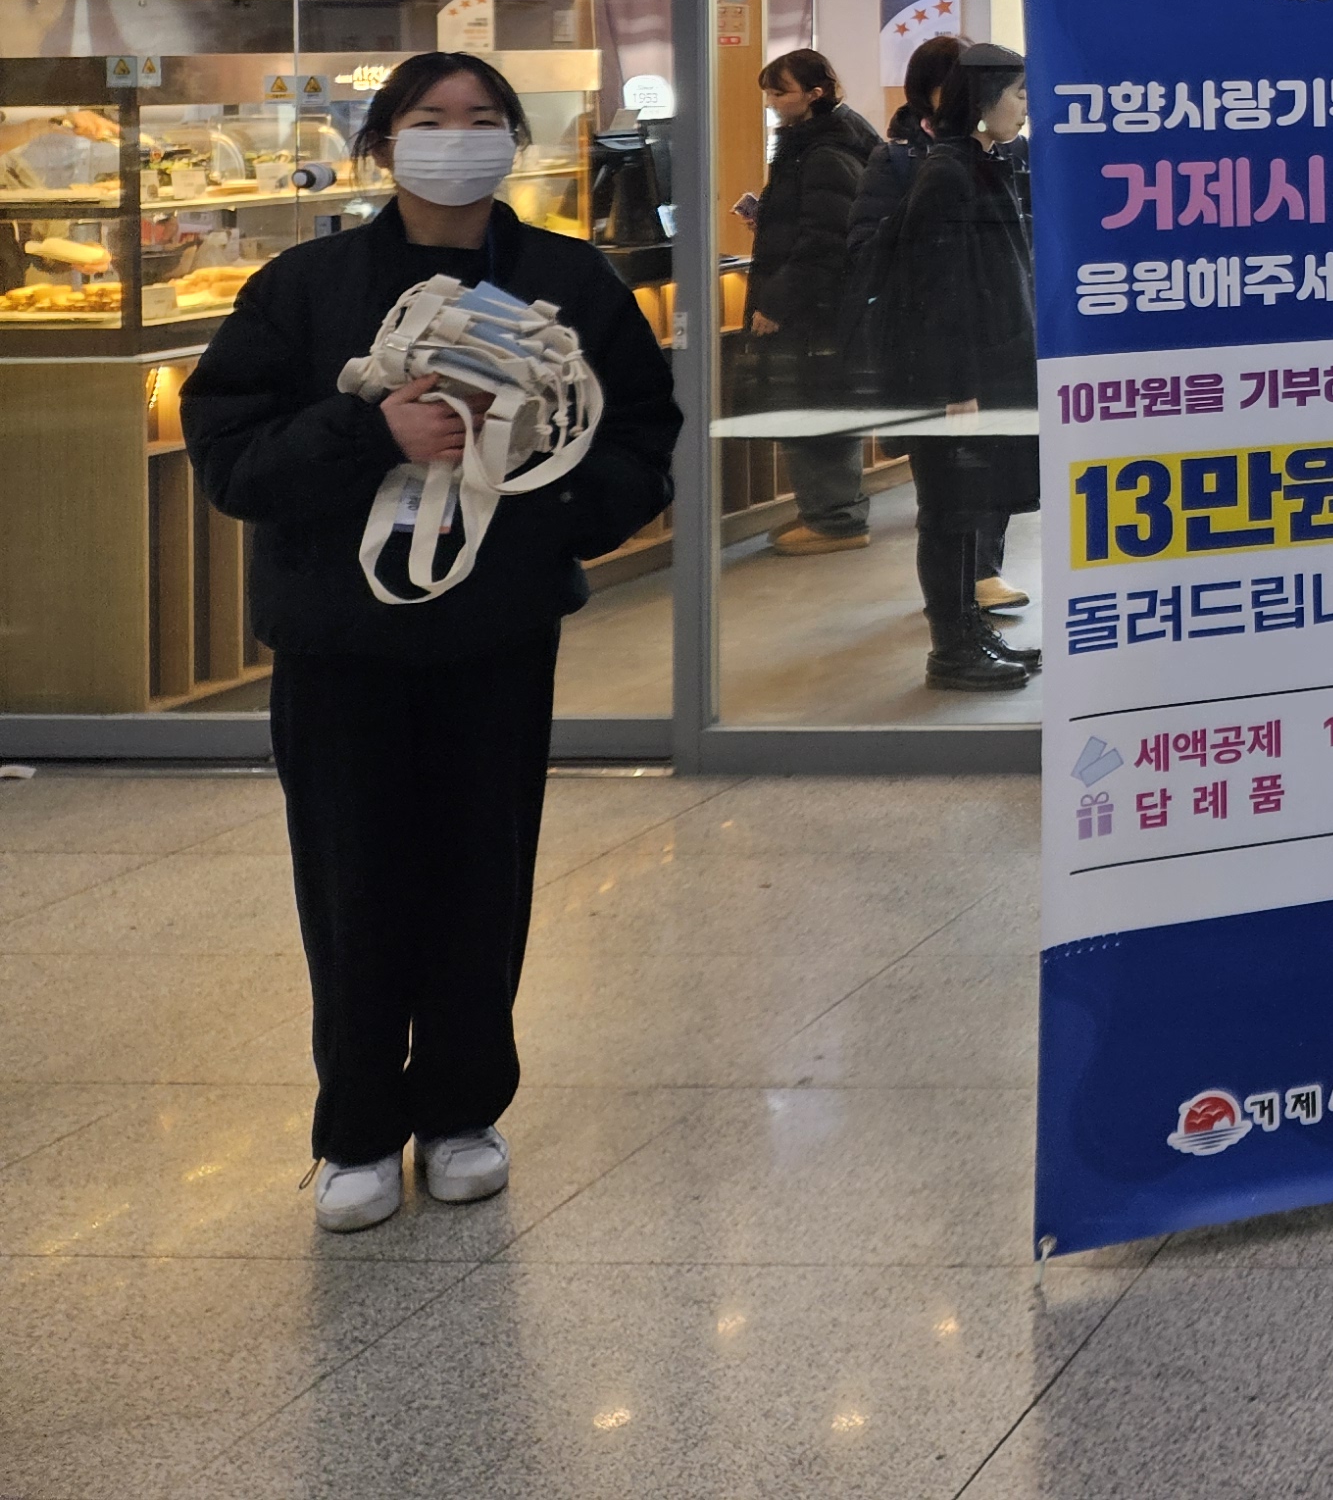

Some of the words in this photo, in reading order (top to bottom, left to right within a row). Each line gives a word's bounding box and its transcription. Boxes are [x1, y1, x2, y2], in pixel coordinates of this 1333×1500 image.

[1057, 372, 1225, 425] 10만원을
[1134, 719, 1283, 772] 세액공제
[1136, 774, 1286, 830] 답례품
